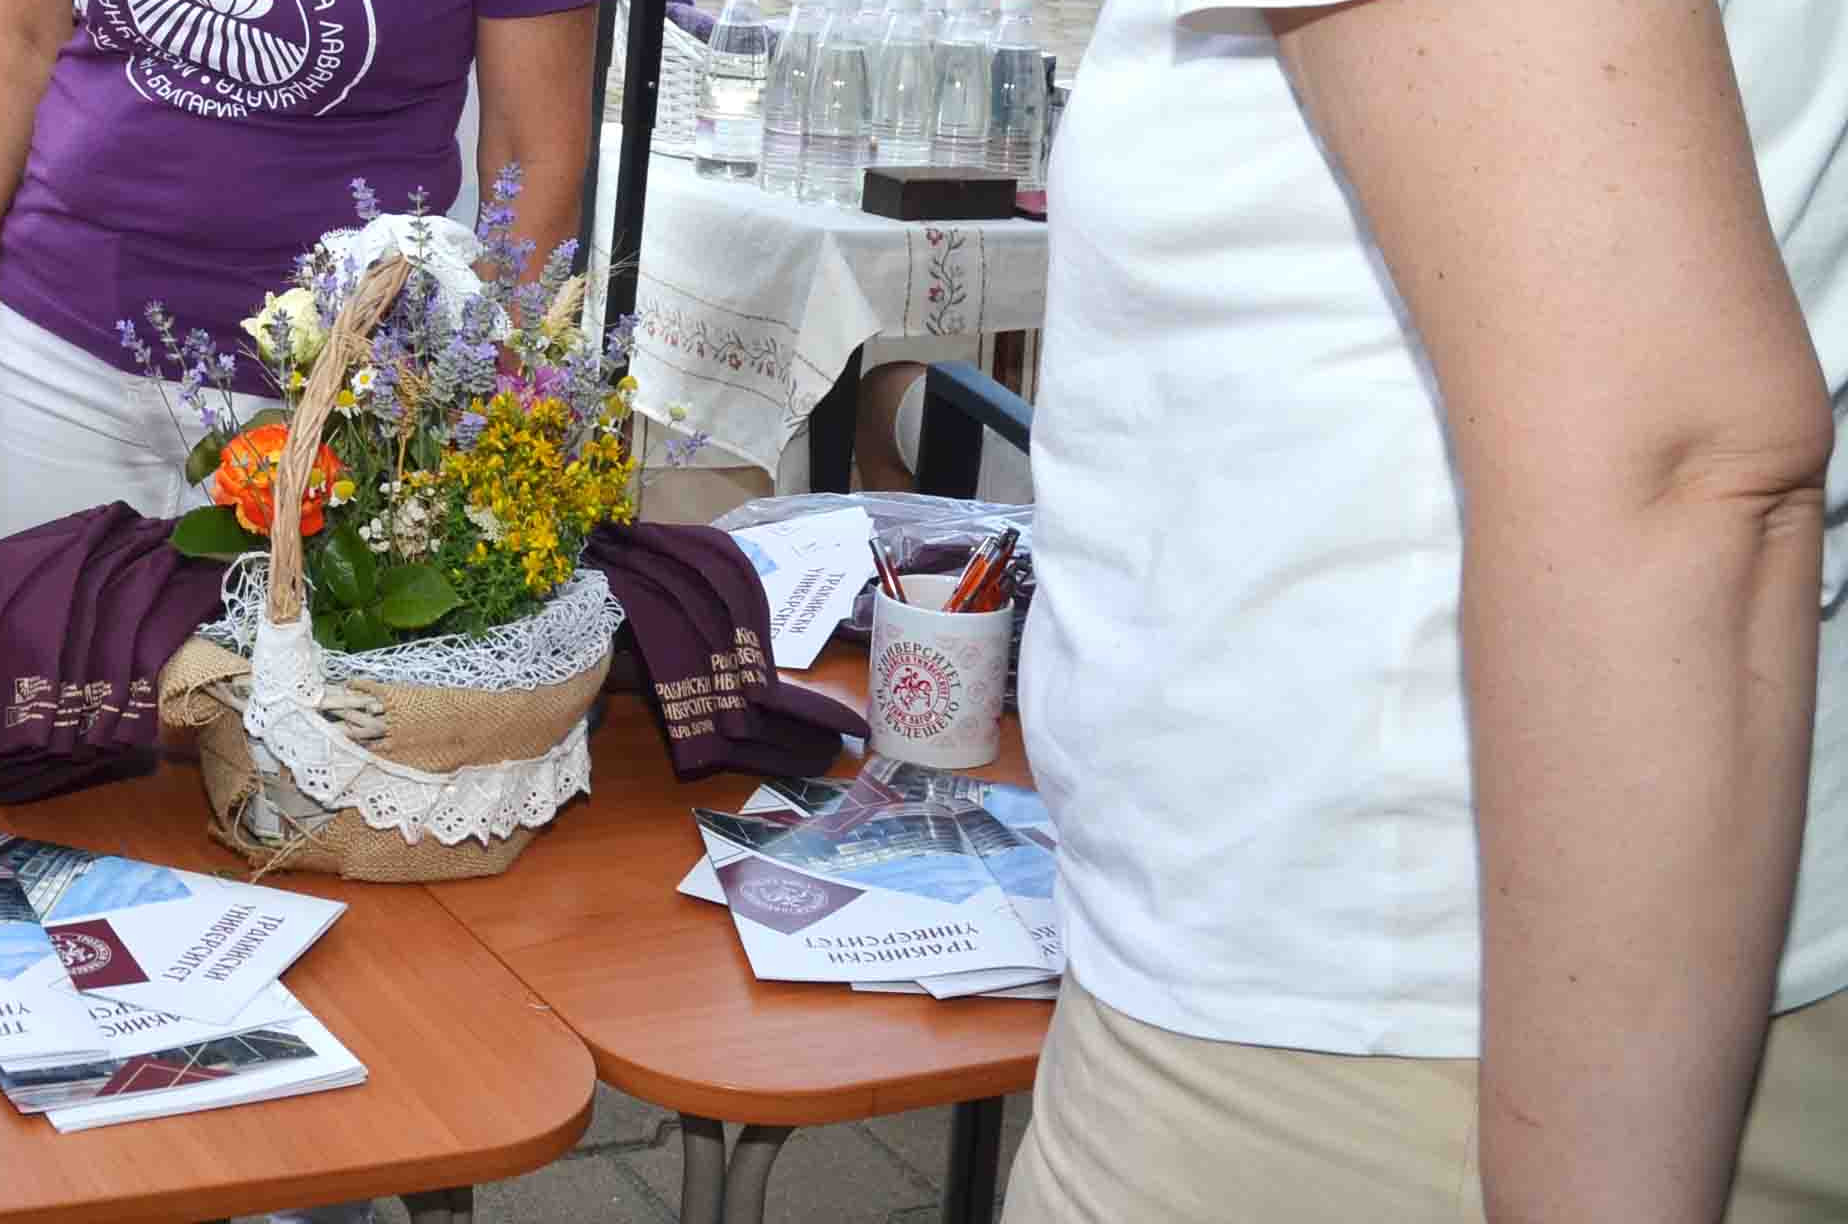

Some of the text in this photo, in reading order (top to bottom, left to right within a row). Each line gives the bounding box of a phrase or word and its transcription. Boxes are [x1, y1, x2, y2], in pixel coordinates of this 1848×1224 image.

[215, 19, 345, 110] ЛАВАНДУЛАТА
[147, 73, 249, 118] БЪЛГАРИЯ
[770, 568, 824, 640] УНИВЕРСИТЕ
[802, 921, 980, 950] УНИВЕРСИТЕТ
[828, 940, 978, 966] ТРАКИЙСКИ
